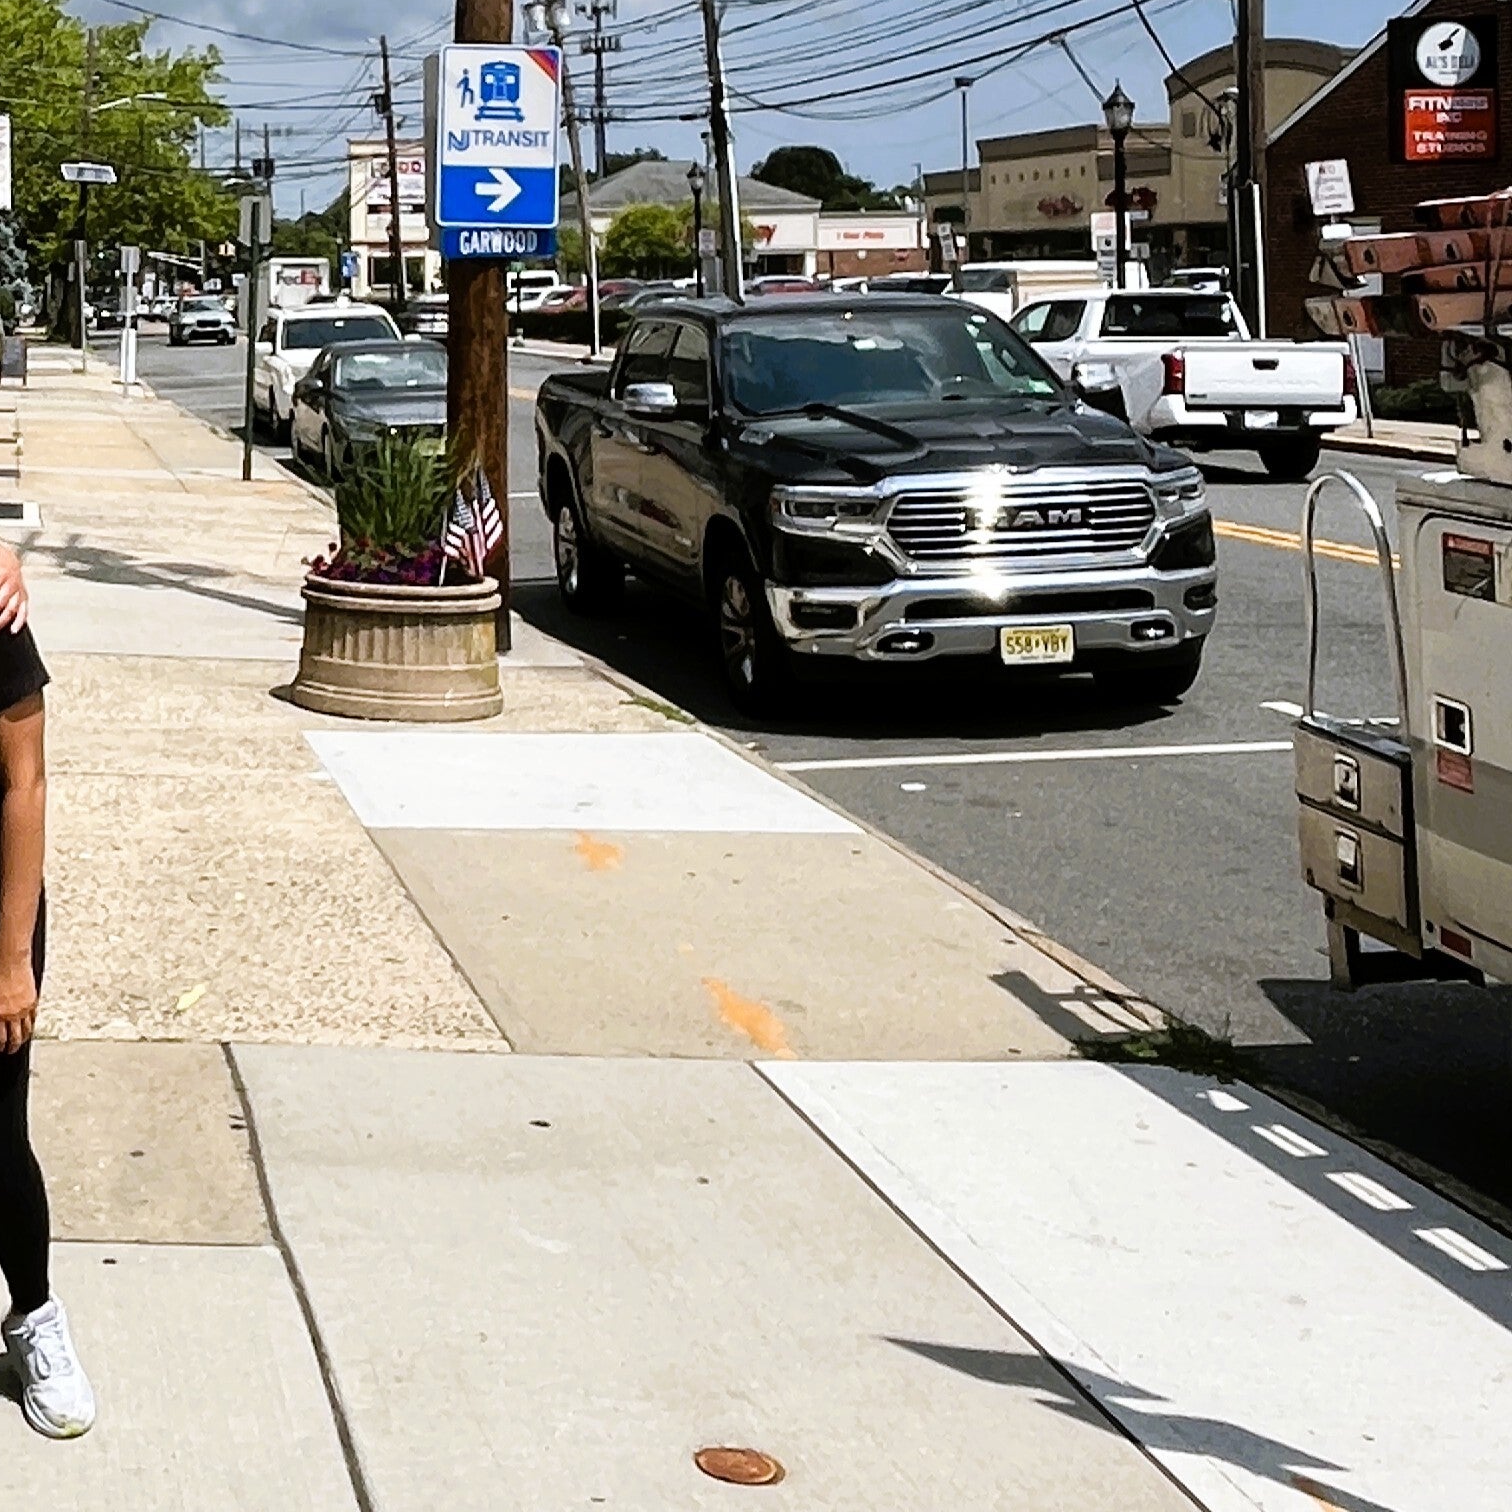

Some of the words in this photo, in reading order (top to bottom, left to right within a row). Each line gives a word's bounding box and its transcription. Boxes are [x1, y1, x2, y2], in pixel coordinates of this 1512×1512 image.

[448, 129, 470, 152] NJ
[474, 130, 549, 149] TRANSIT
[459, 230, 539, 256] GARWOOD
